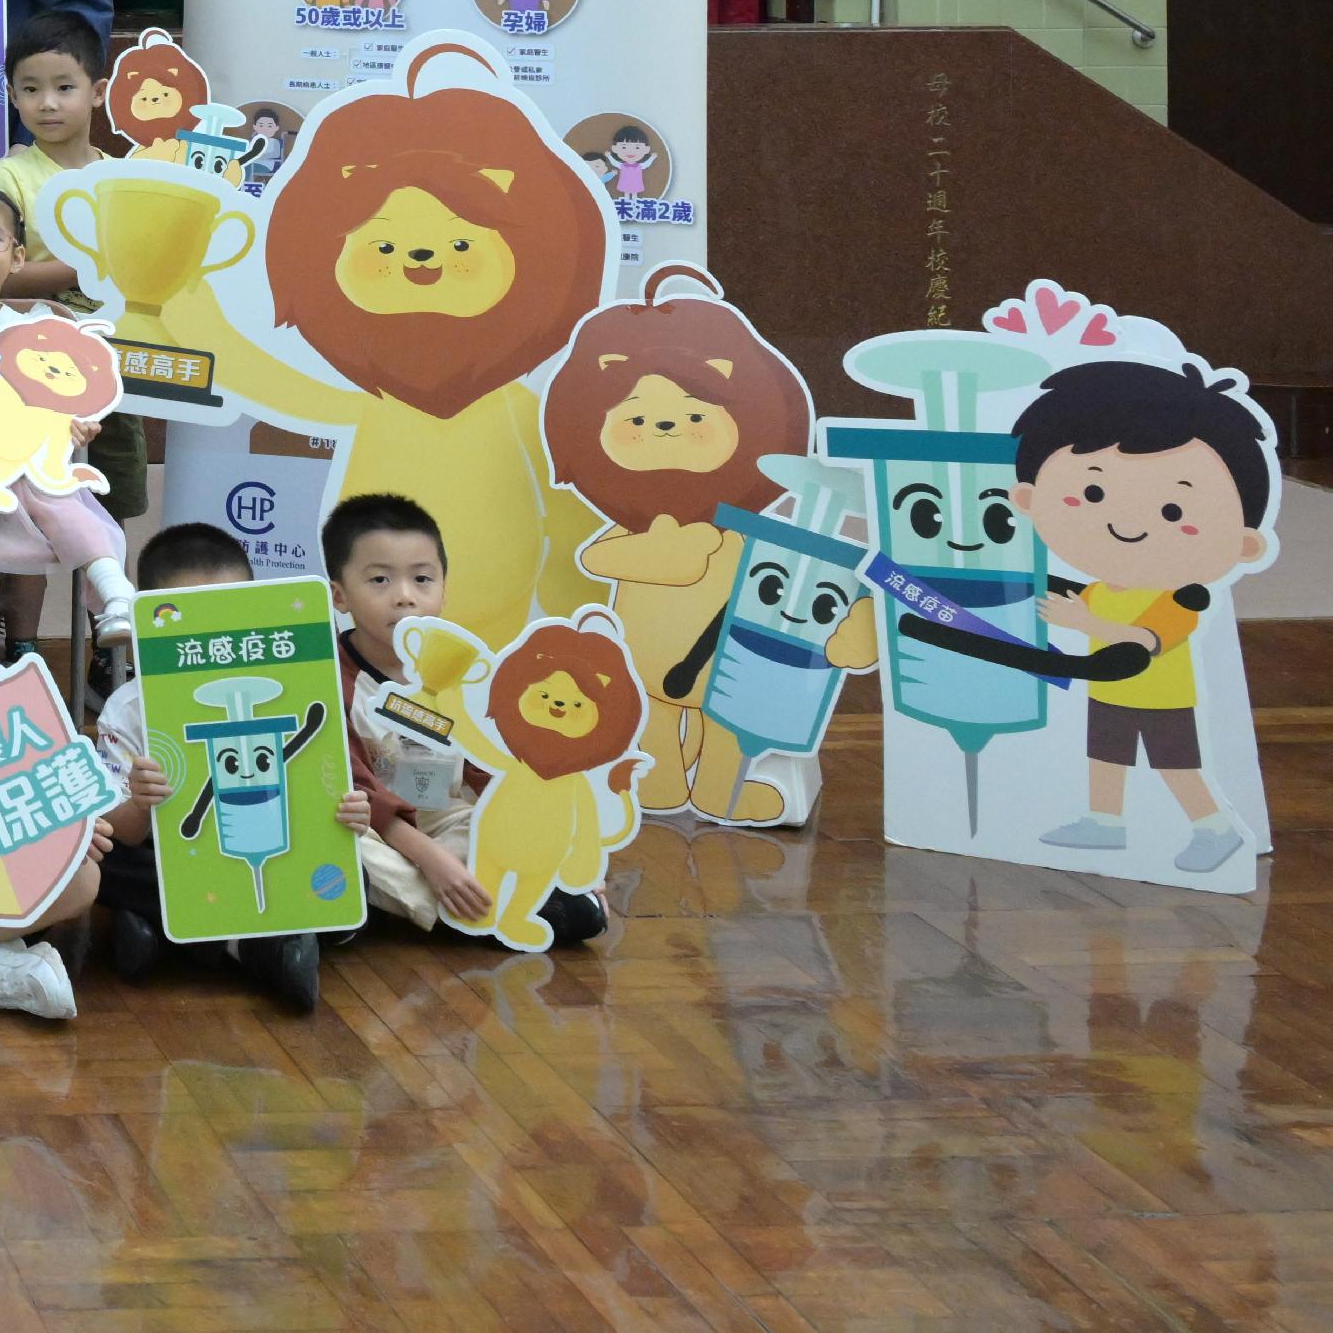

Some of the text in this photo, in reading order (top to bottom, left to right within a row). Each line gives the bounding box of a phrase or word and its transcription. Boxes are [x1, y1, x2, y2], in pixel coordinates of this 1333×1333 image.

[295, 7, 405, 29] 50歲或以上
[502, 11, 548, 33] 孕婦
[615, 199, 692, 223] 未滿2歲
[266, 558, 306, 570] Protection
[884, 570, 958, 623] 流感疫苗
[175, 631, 297, 668] 流感疫苗
